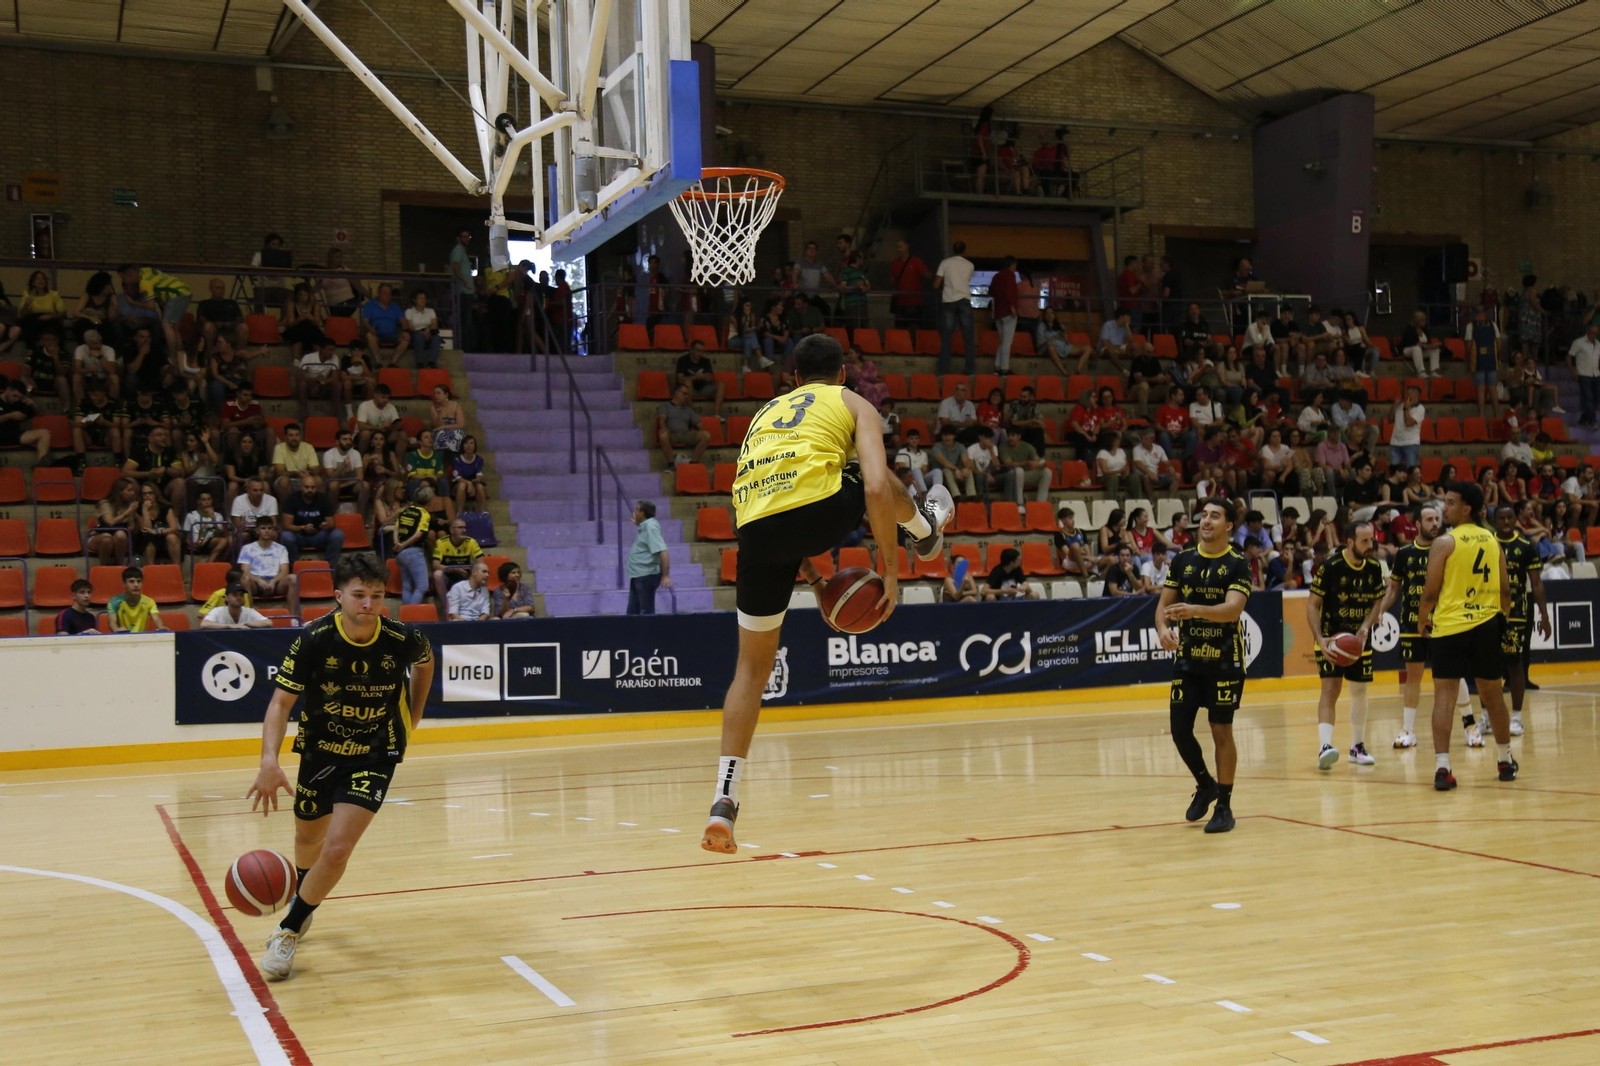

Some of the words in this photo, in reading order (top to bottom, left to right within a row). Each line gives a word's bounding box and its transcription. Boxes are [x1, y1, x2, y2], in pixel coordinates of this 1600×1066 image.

[1351, 215, 1362, 234] B
[756, 451, 796, 466] HINALASA
[749, 481, 760, 490] LA
[761, 470, 798, 486] FORTUNA
[1472, 549, 1490, 582] 4
[1037, 634, 1065, 645] oficina
[1067, 633, 1079, 642] de
[1190, 627, 1223, 637] OCISUR
[828, 635, 937, 666] Blanca
[1038, 645, 1079, 655] servicios
[1095, 652, 1148, 664] CLIMBING
[1151, 649, 1178, 660] CENT
[615, 649, 679, 679] Jaén
[1037, 656, 1079, 668] agrícolas
[449, 665, 494, 681] UNED
[523, 666, 542, 677] JAÉN
[829, 665, 889, 679] impresores
[615, 677, 657, 688] PARAÍSO
[658, 676, 702, 688] INTERIOR
[830, 680, 856, 688] Soluciones
[1217, 689, 1231, 701] LZ
